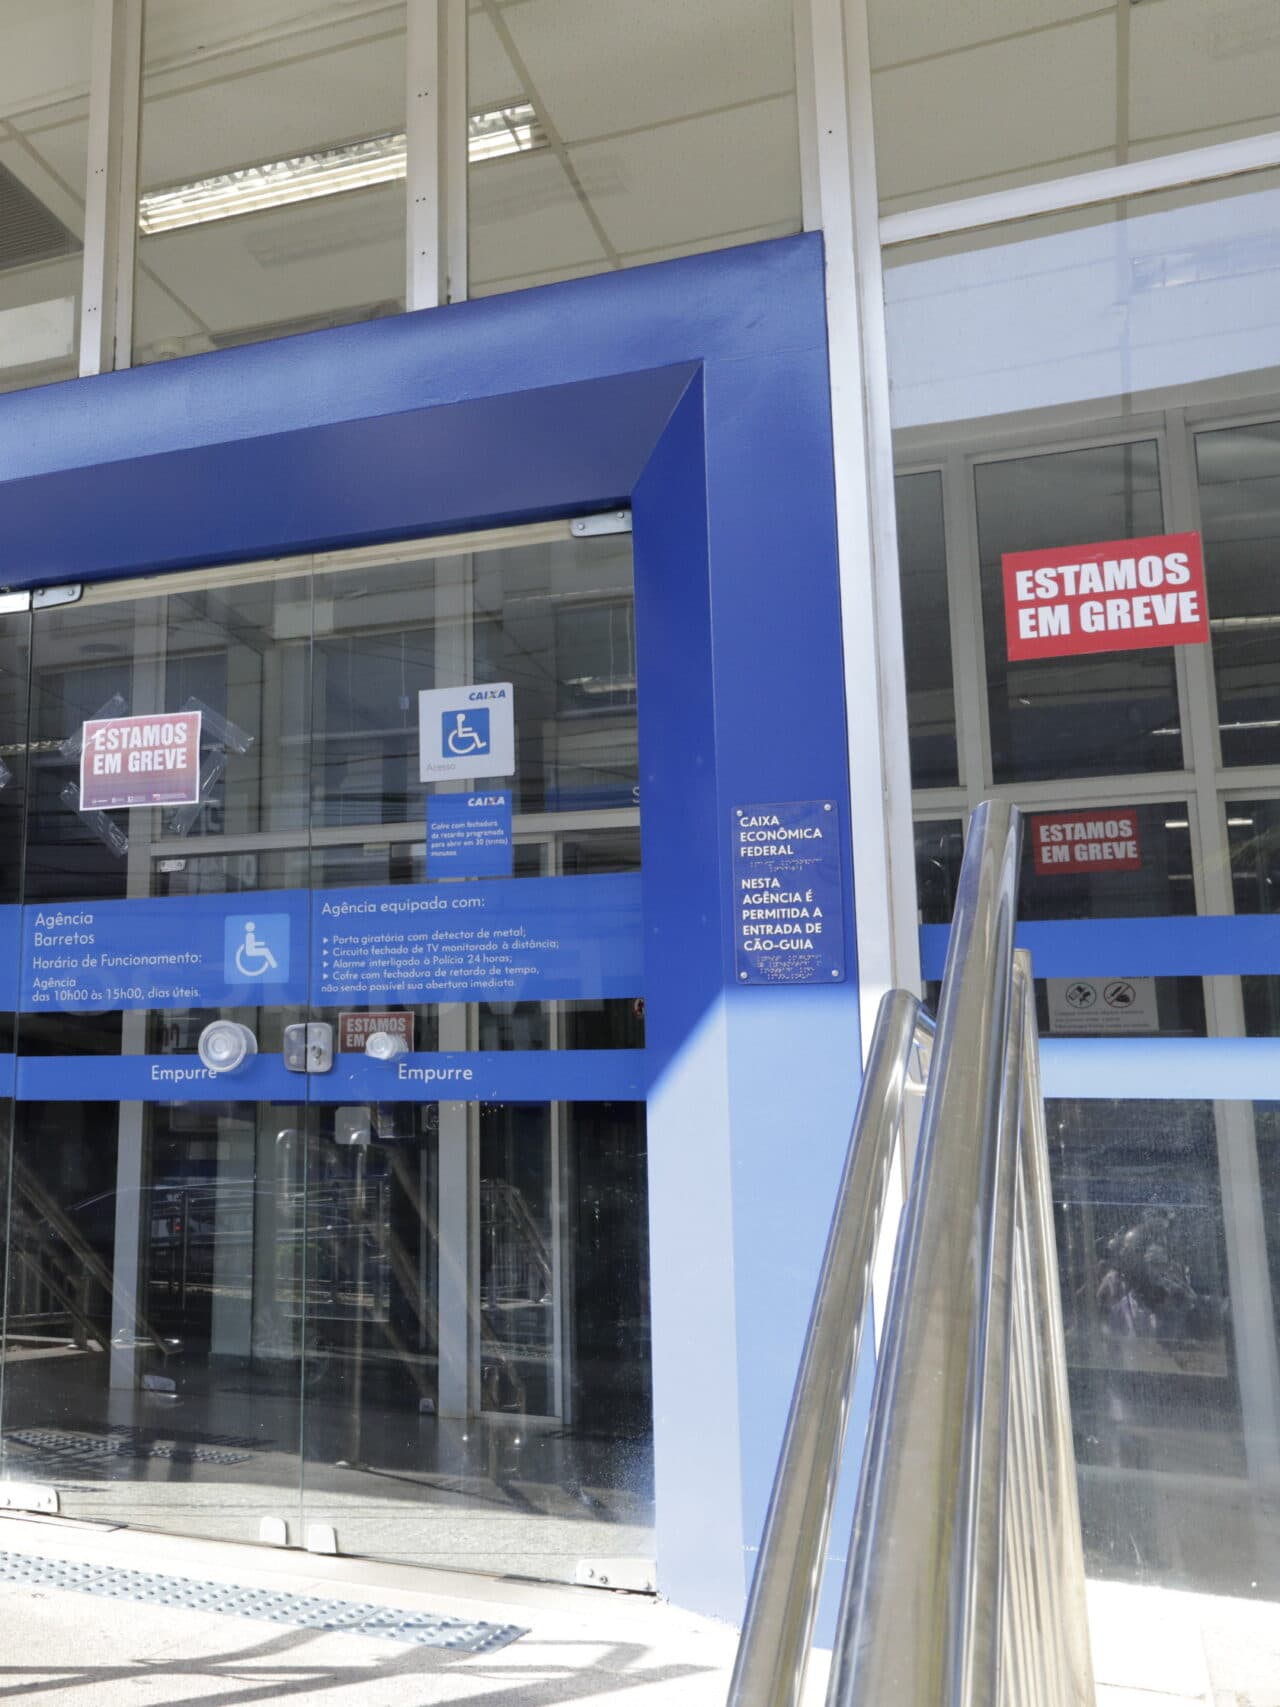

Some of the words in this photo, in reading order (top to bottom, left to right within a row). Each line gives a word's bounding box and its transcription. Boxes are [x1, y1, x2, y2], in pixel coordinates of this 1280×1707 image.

[1015, 552, 1191, 602] ESTAMOS
[1019, 604, 1071, 640] EM
[1079, 590, 1201, 633] GREVE
[468, 689, 506, 701] CAIXA
[94, 722, 188, 751] ESTAMOS
[93, 752, 122, 775] EM
[128, 747, 187, 773] GREVE
[467, 796, 505, 807] CAIXA
[739, 815, 780, 828] CAIXA
[739, 827, 823, 842] ECONÔMICA
[1040, 819, 1133, 843] ESTAMOS
[740, 845, 795, 857] FEDERAL
[1041, 844, 1070, 864] EM
[1074, 840, 1138, 862] GREVE
[741, 877, 781, 890] NESTA
[742, 890, 803, 905] AGÊNCIA
[805, 888, 814, 903] É
[322, 900, 377, 917] Agência
[380, 896, 447, 914] equipada
[452, 897, 486, 909] com:
[742, 907, 810, 921] PERMITIDA
[813, 906, 824, 918] A
[34, 911, 94, 930] Agência
[332, 934, 360, 945] Porta
[361, 933, 405, 946] giratória
[407, 933, 429, 942] com
[431, 930, 475, 940] detector
[477, 928, 490, 938] de
[493, 926, 527, 938] metal;
[742, 923, 803, 936] ENTRADA
[805, 922, 823, 934] DE
[34, 931, 95, 948] Barretos
[743, 937, 814, 951] CÃO-GUIA
[332, 946, 369, 957] Circuito
[371, 945, 409, 955] fechado
[411, 944, 424, 954] de
[427, 943, 440, 953] TV
[441, 941, 498, 952] monitorado
[502, 941, 509, 950] à
[511, 939, 560, 950] distância;
[32, 956, 79, 969] Horário
[81, 954, 98, 968] de
[101, 952, 202, 967] Funcionamento:
[332, 959, 366, 969] Alarme
[369, 957, 421, 968] interligado
[432, 955, 464, 965] Polícia
[467, 954, 481, 964] 24
[482, 953, 513, 964] horas;
[332, 970, 359, 981] Cofre
[361, 971, 380, 980] com
[383, 968, 431, 979] fechadura
[434, 968, 447, 977] de
[450, 966, 486, 976] retardo
[489, 965, 502, 975] de
[505, 966, 540, 976] tempo,
[32, 976, 77, 991] Agência
[321, 983, 339, 993] não
[341, 982, 368, 992] sendo
[407, 982, 424, 991] sua
[425, 979, 468, 990] abertura
[32, 990, 50, 1002] das
[54, 989, 89, 1002] 10h00
[91, 989, 103, 1001] às
[106, 987, 145, 1001] 15h00,
[148, 986, 170, 999] dias
[346, 1017, 407, 1033] ESTAMOS
[346, 1033, 365, 1048] EM
[151, 1064, 218, 1084] Empurre
[398, 1063, 473, 1085] Empurre
